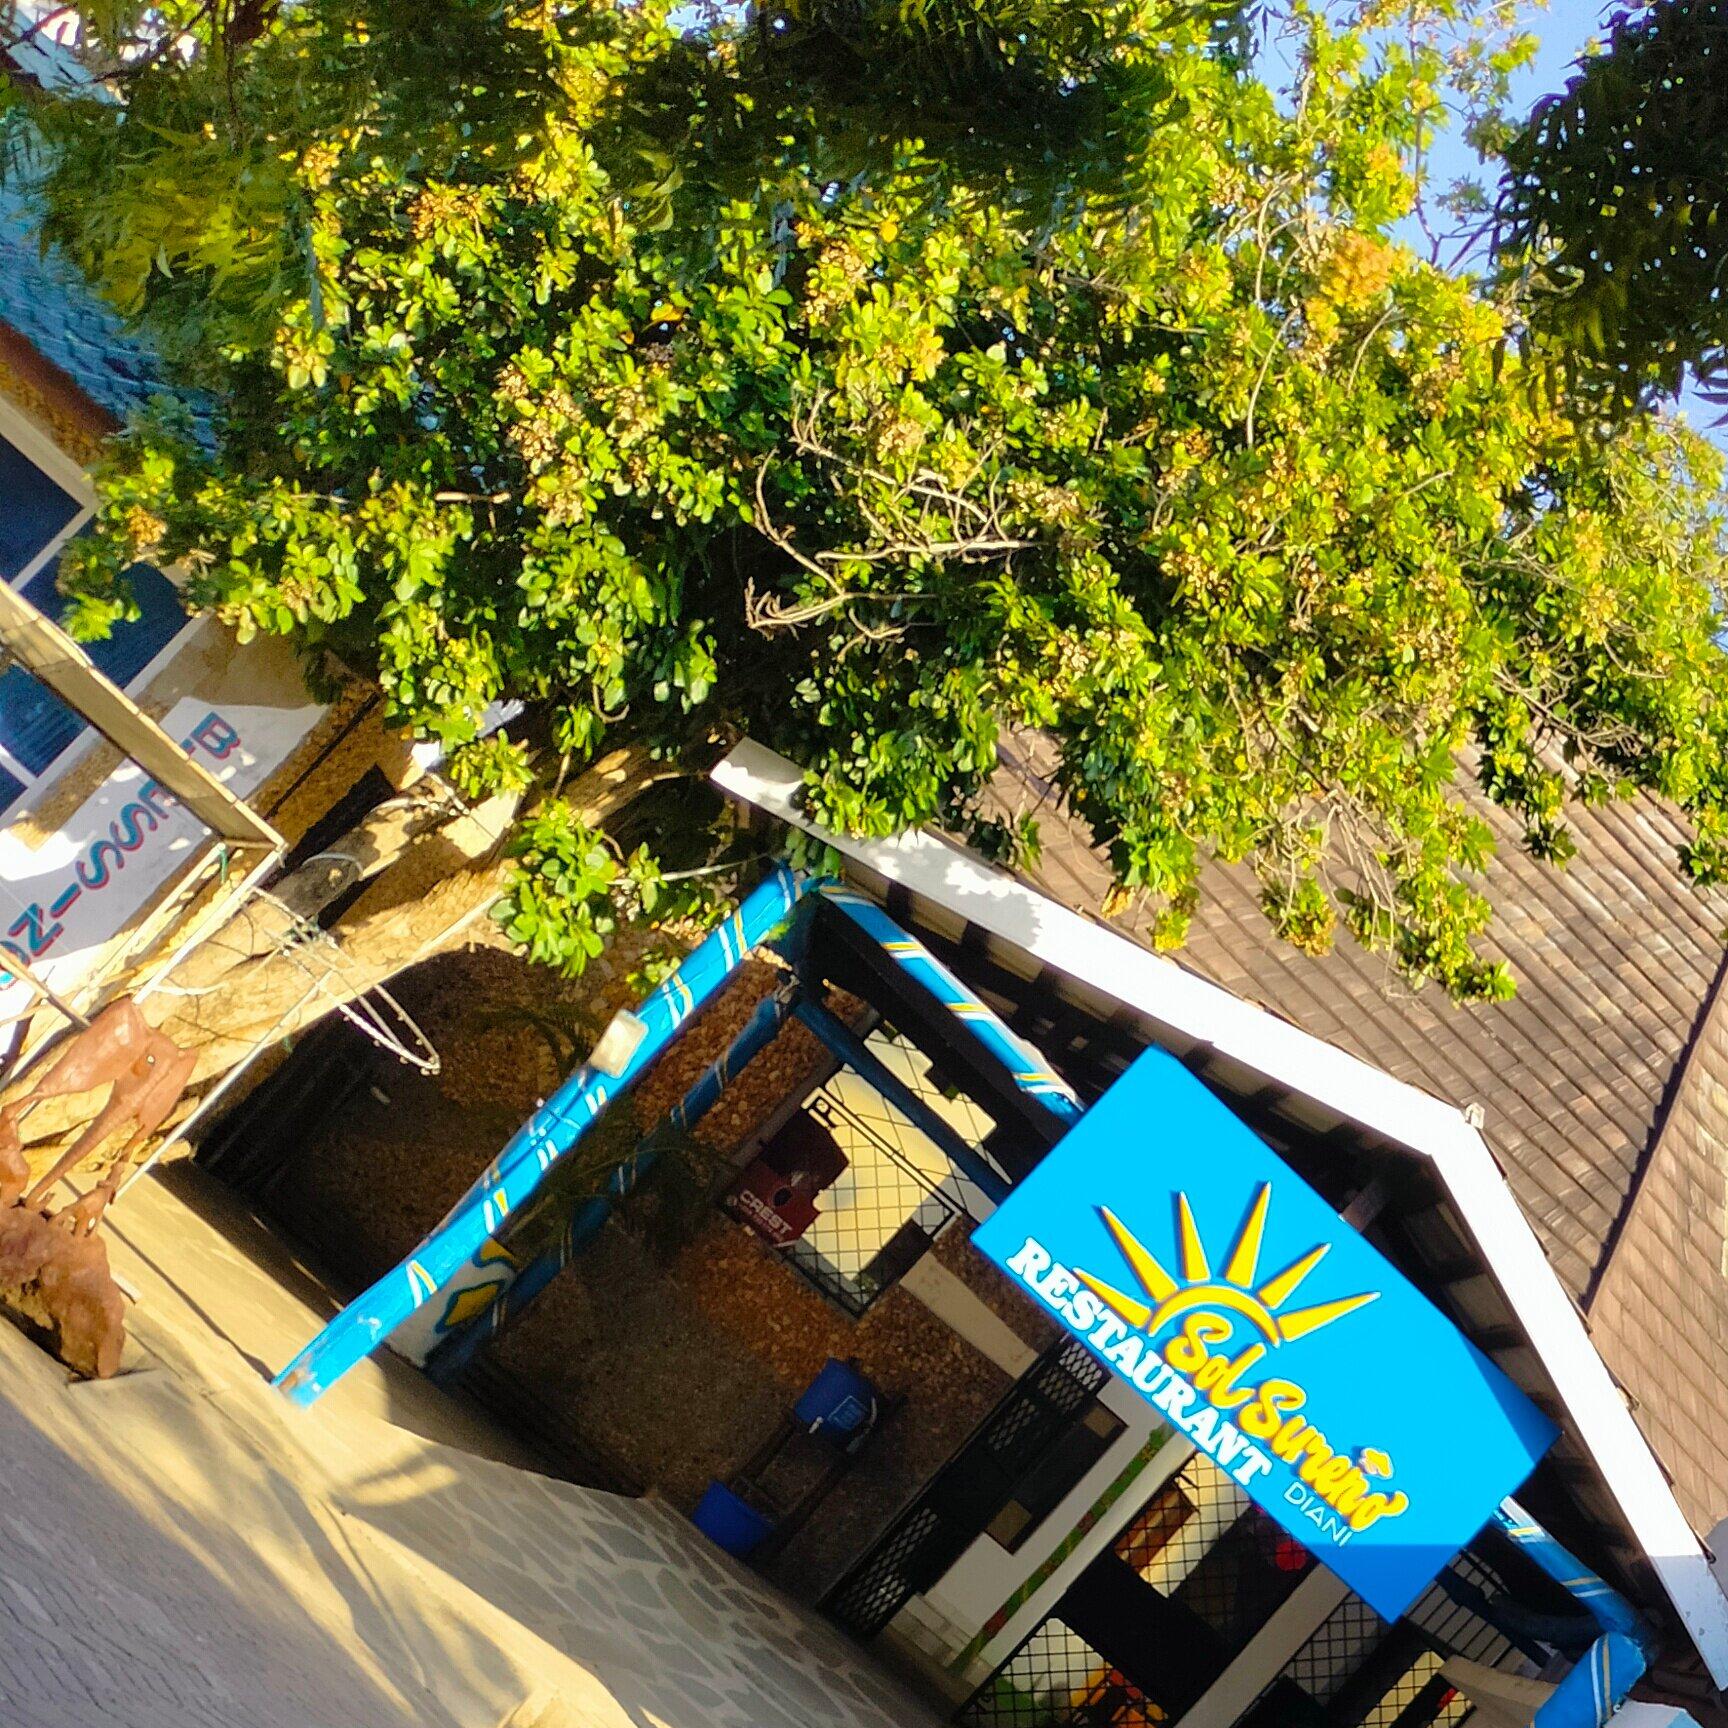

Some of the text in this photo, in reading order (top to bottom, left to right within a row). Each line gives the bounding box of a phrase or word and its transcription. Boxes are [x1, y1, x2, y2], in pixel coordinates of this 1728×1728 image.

[739, 1189, 793, 1234] CREST
[1007, 1237, 1271, 1484] RESTAURANT
[1164, 1311, 1266, 1408] Sol
[1284, 1481, 1352, 1546] DIANI
